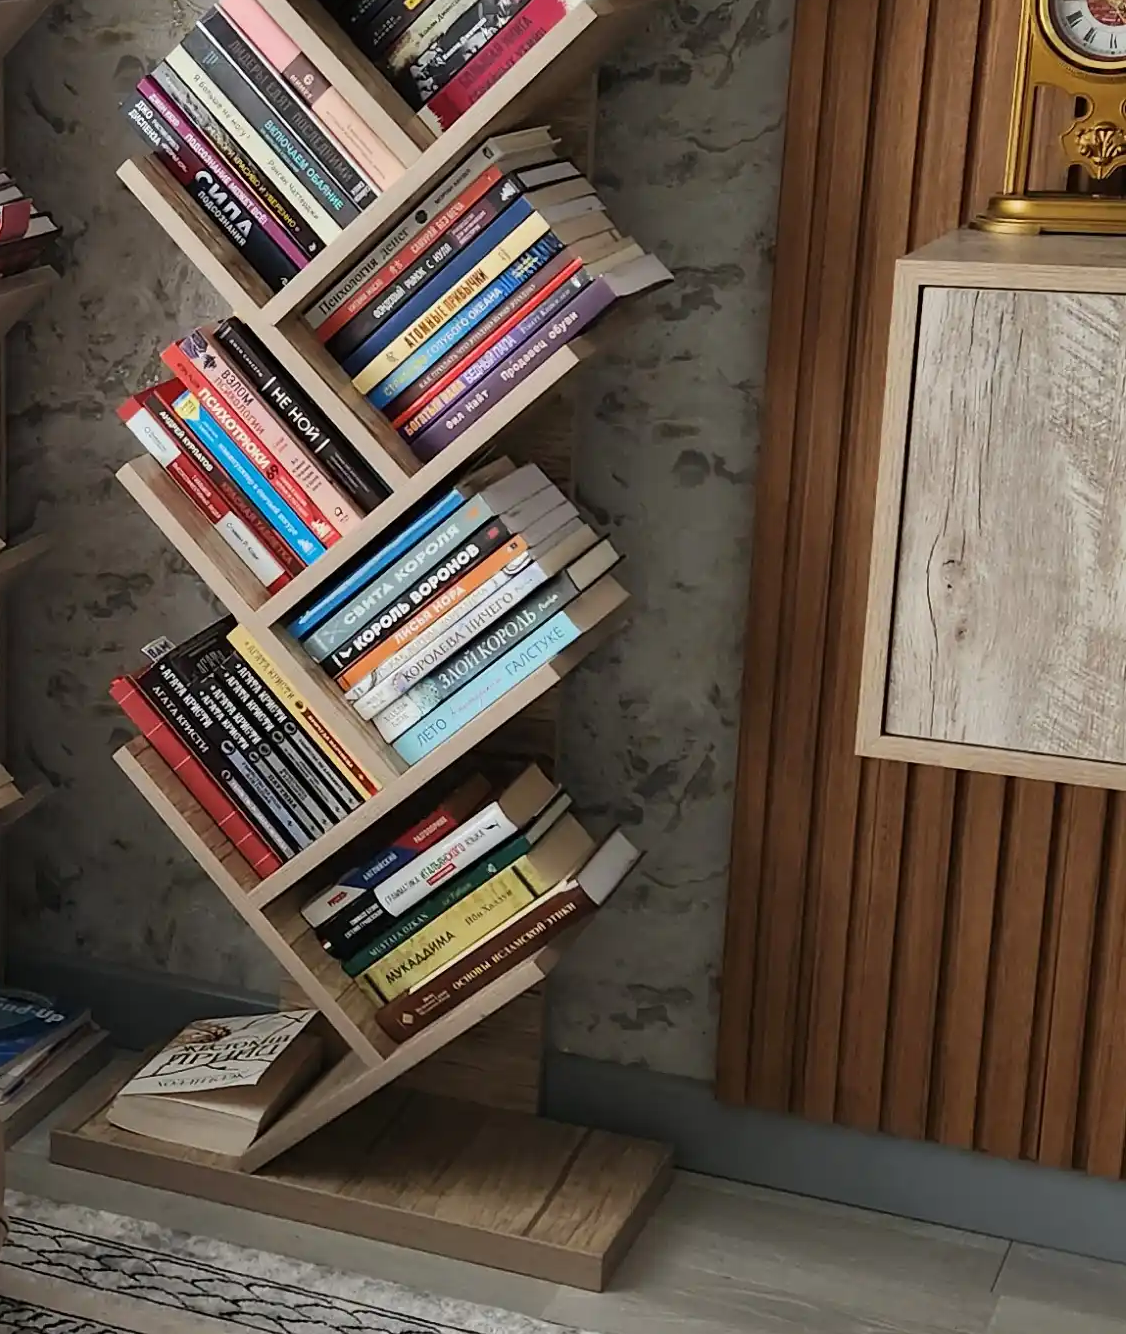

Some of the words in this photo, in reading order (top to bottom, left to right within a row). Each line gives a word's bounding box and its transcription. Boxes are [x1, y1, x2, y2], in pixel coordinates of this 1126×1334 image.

[134, 99, 154, 120] ДЖО
[287, 73, 314, 101] МИНУТ
[301, 71, 316, 86] 6
[127, 108, 163, 146] ДИСПЕНЗА
[225, 38, 271, 87] ЛИДЕРЫ
[263, 80, 294, 113] ЕДЯТ
[289, 110, 356, 183] ПОСЛЕДНИМИ
[262, 119, 310, 171] ВКЛЮЧАЕМ
[304, 166, 345, 211] ОБАЯНИЕ
[192, 167, 257, 238] СИЛА
[196, 189, 247, 246] ПОДСОЗНАНИЯ
[435, 215, 450, 230] БЕЗ
[446, 201, 465, 219] МЕЧА
[317, 256, 379, 316] Психология
[377, 226, 412, 259] денег
[370, 285, 407, 320] ФОНДОВЫЙ
[425, 260, 434, 269] С
[431, 242, 453, 263] НУЛЯ
[402, 305, 448, 349] АТОМНЫЕ
[442, 268, 489, 312] ПРИВЫЧКИ
[424, 315, 471, 358] ГОЛУБОГО
[466, 285, 503, 321] ОКЕАНА
[219, 368, 255, 407] ВЗЛОМ
[444, 410, 466, 431] Фил
[464, 388, 491, 413] Найт
[498, 336, 548, 383] Продавец
[545, 308, 579, 340] обуви
[195, 386, 271, 471] ПСИХОТРЮКИ
[269, 385, 293, 411] НЕ
[286, 405, 321, 443] НОЙ
[157, 409, 185, 439] АНДРЕЙ
[180, 435, 214, 473] КУРПАТОВ
[219, 480, 257, 523] КРАСНАЯ
[253, 520, 294, 565] ТАБЛЕТКА
[341, 579, 395, 627] СВИТА
[392, 522, 461, 583] КОРОЛЯ
[351, 598, 412, 652] КОРОЛЬ
[407, 540, 482, 606] ВОРОНОВ
[392, 609, 433, 645] ЛИСЬЯ
[431, 583, 466, 614] НОРА
[400, 628, 468, 684] КОРОЛЕВА
[462, 589, 515, 634] НИЧЕГО
[434, 648, 482, 690] ЗЛОЙ
[474, 605, 539, 661] КОРОЛЬ
[503, 624, 566, 677] ГАЛСТУКЕ
[149, 683, 181, 717] АГАТА
[174, 712, 212, 754] КРИСТИ
[159, 666, 187, 698] АГАТА
[180, 692, 214, 729] КРИСТИ
[199, 693, 226, 721] АГАТА
[219, 716, 251, 751] КРИСТИ
[210, 687, 237, 716] АГАТА
[231, 710, 263, 745] КРИСТИ
[223, 674, 251, 703] АГАТА
[243, 698, 276, 734] КРИСТИ
[236, 664, 263, 694] АГАТА
[256, 688, 289, 724] КРИСТИ
[414, 716, 449, 747] ЛЕТО
[264, 772, 300, 810] ПАУТИНА
[382, 874, 421, 906] ГРАММАТИКА
[383, 928, 456, 984] МУКАДДИМА
[451, 959, 492, 991] ОСНОВЫ
[489, 920, 547, 965] ИСЛАМСКОЙ
[543, 900, 576, 927] ЭТИКИ
